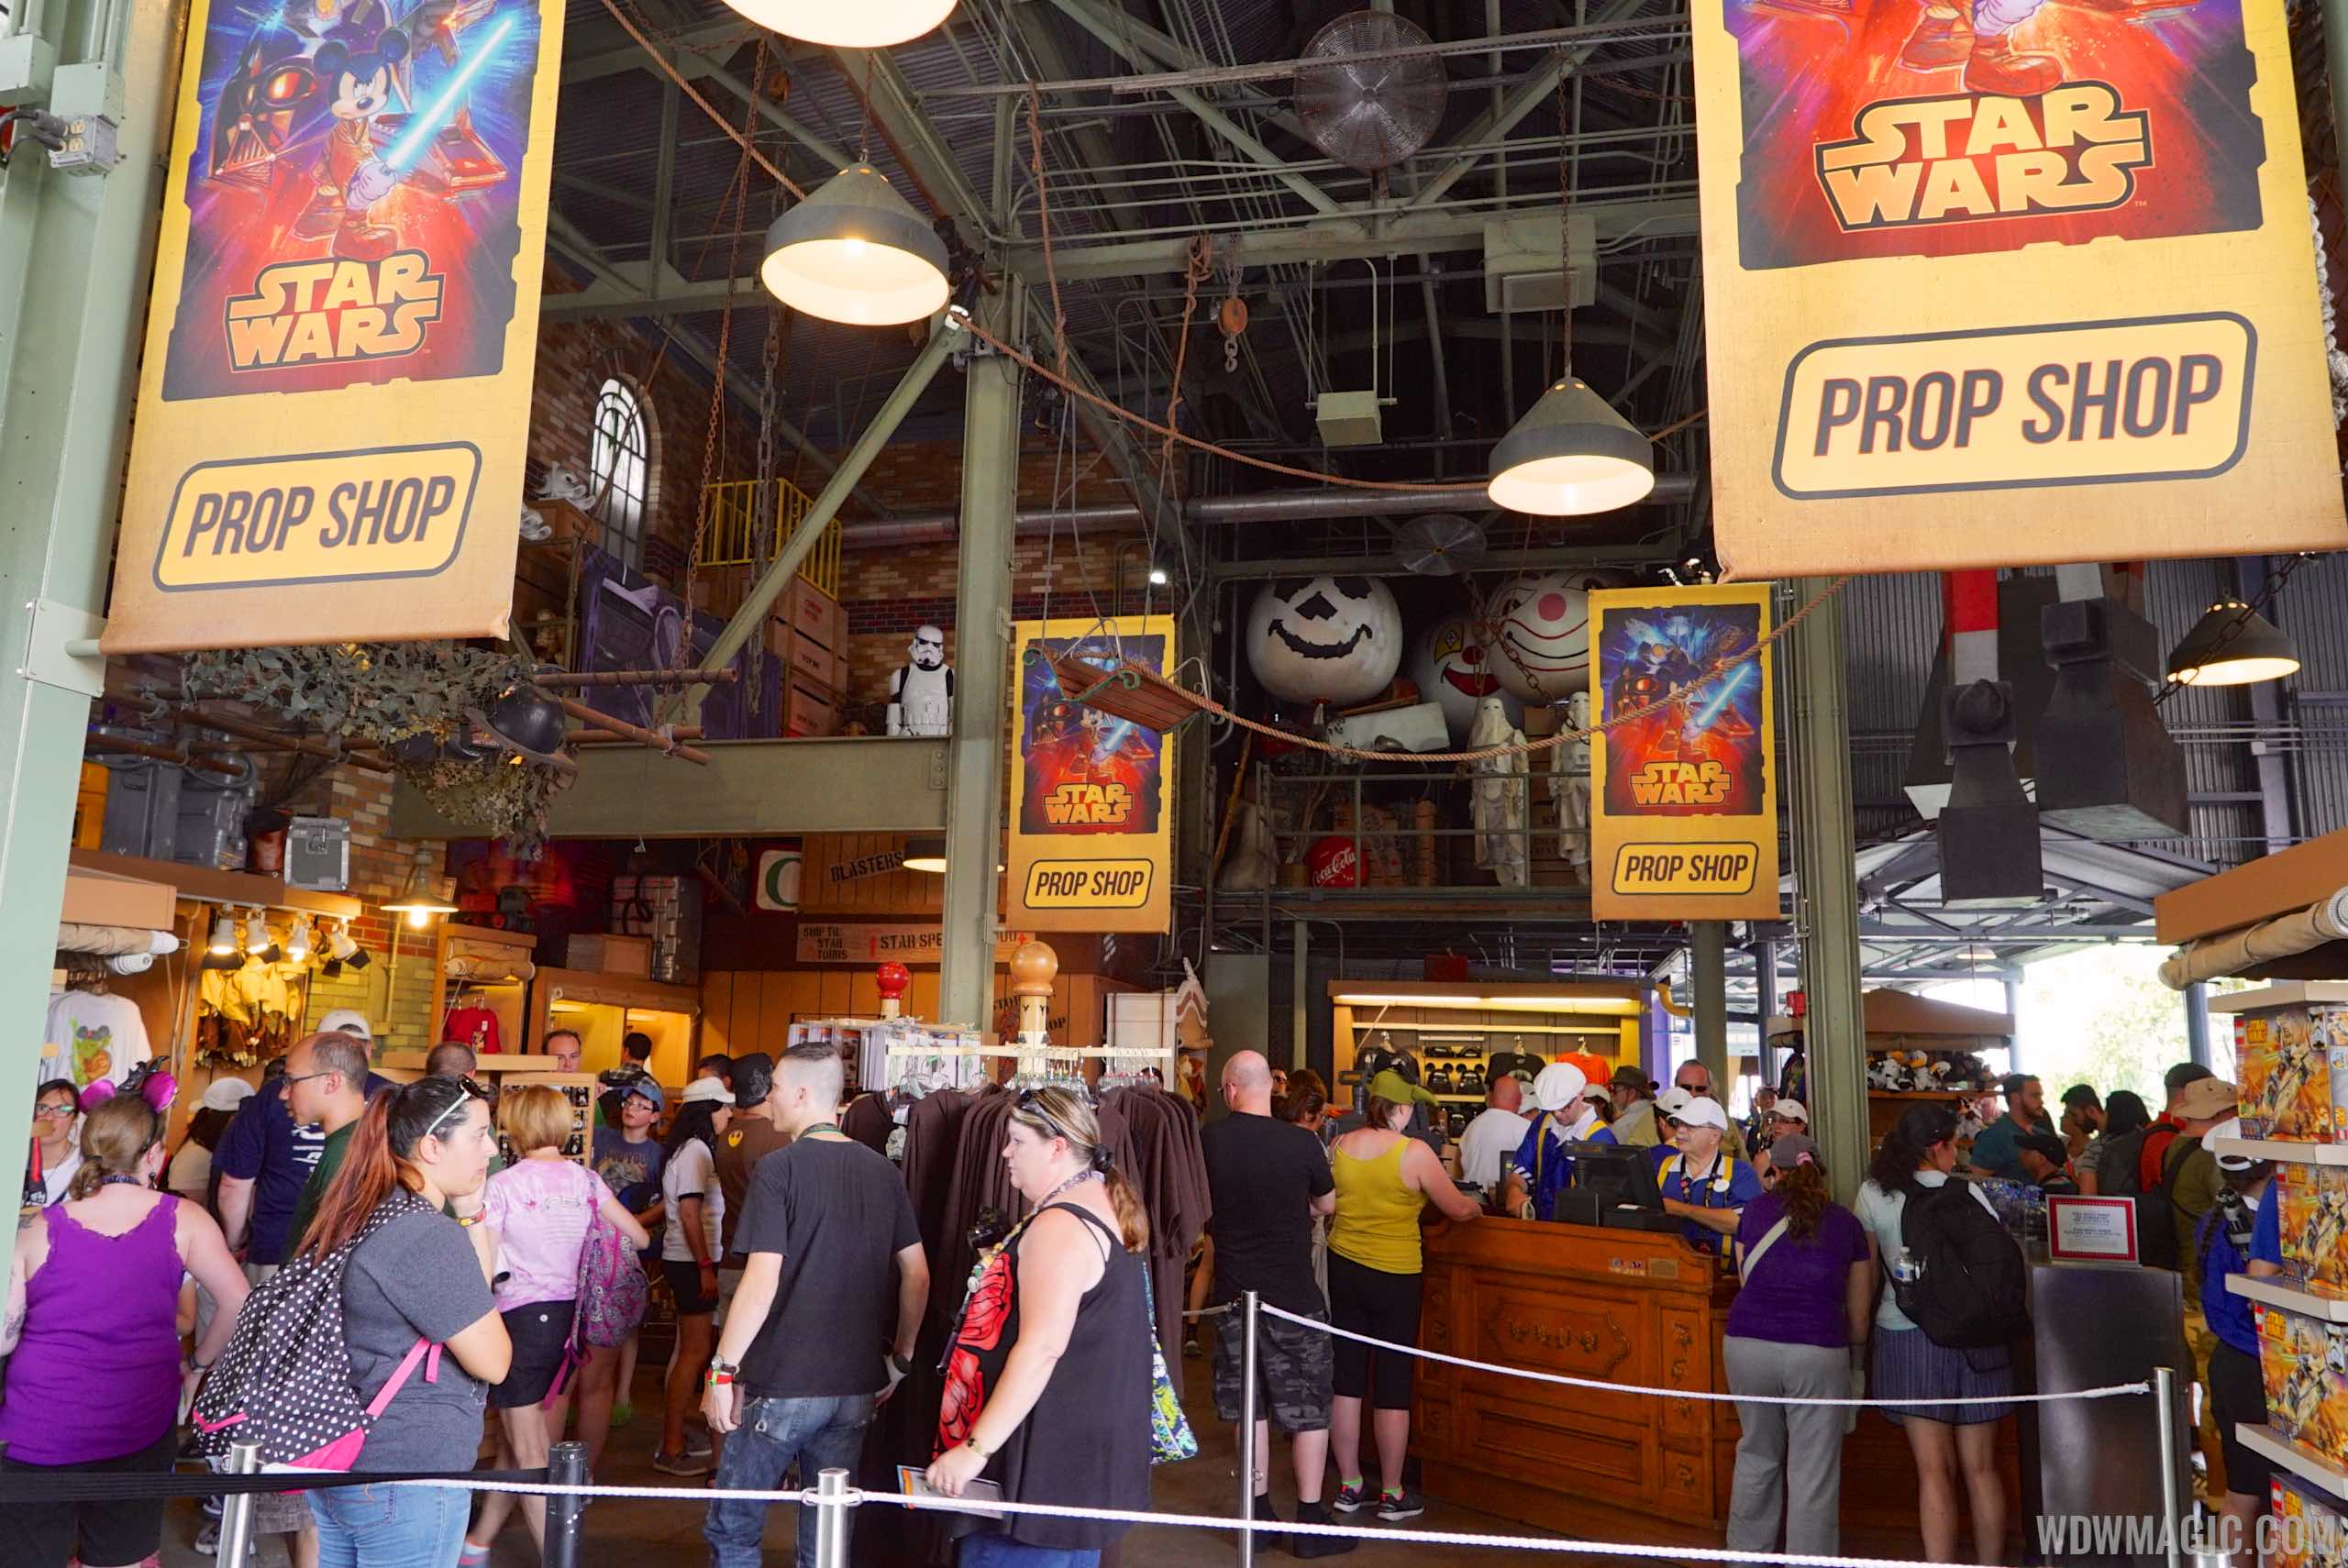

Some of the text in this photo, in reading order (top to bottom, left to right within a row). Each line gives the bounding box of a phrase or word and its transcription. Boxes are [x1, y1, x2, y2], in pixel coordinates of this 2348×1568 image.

[1822, 86, 2143, 171] STAR
[1824, 141, 2145, 225] WARS
[229, 254, 438, 318] STAR
[228, 301, 438, 366] WARS
[1813, 353, 2223, 458] PROP SHOP
[183, 475, 456, 558] PROP SHOP
[1632, 761, 1732, 784] STAR
[1045, 785, 1131, 805] STAR
[1633, 782, 1731, 805] WARS
[1045, 801, 1131, 824] WARS
[830, 851, 903, 882] BLASTERS
[1624, 854, 1748, 881] PROP SHOP
[1035, 870, 1145, 896] PROP SHOP
